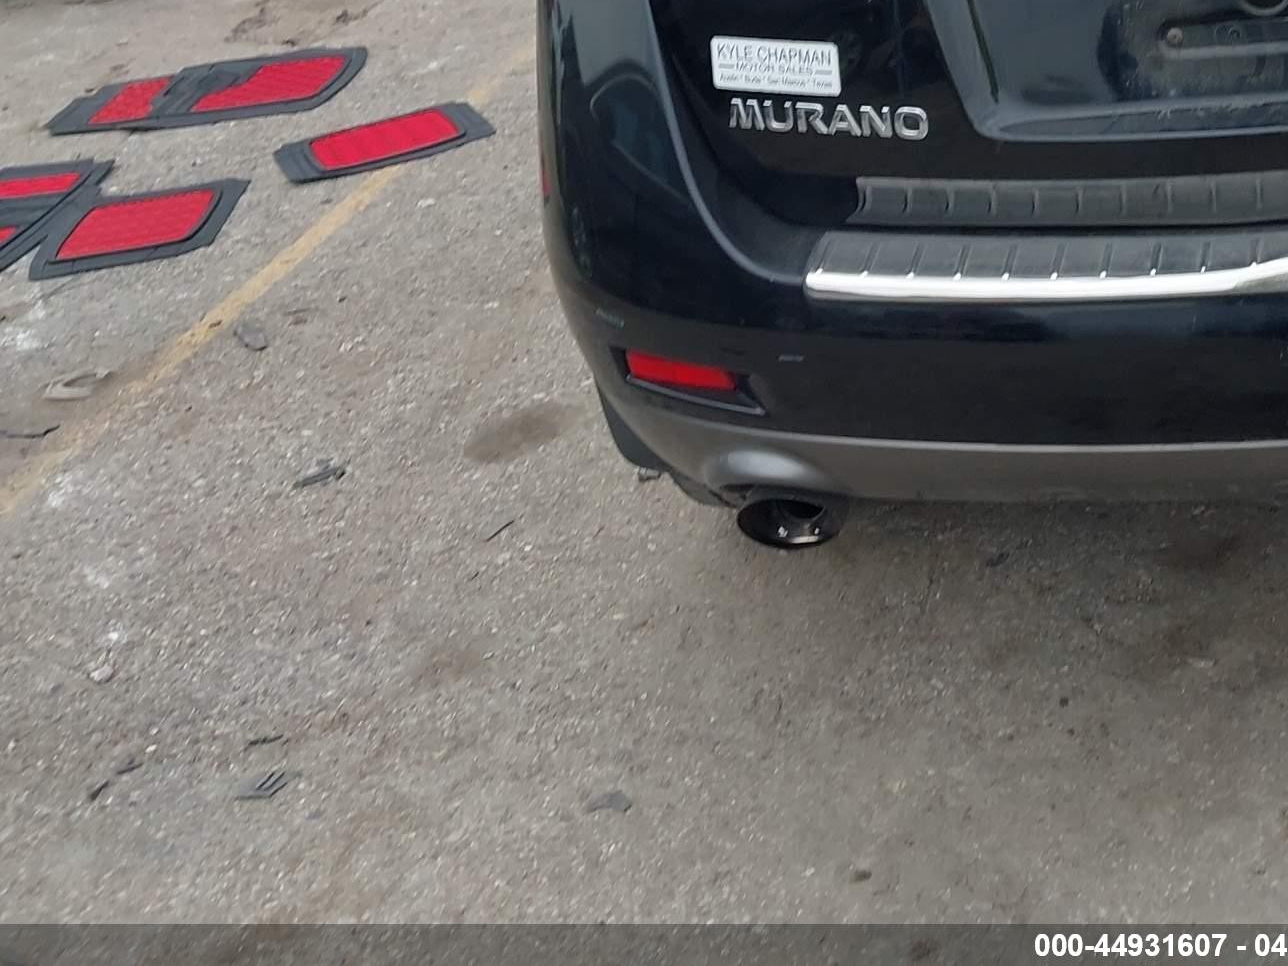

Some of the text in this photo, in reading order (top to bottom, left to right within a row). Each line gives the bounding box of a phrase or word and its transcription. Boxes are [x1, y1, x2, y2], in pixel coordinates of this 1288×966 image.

[717, 43, 832, 67] KYLE CHAPMAN
[736, 62, 814, 76] MOTOR SALES
[729, 97, 929, 141] MURANO
